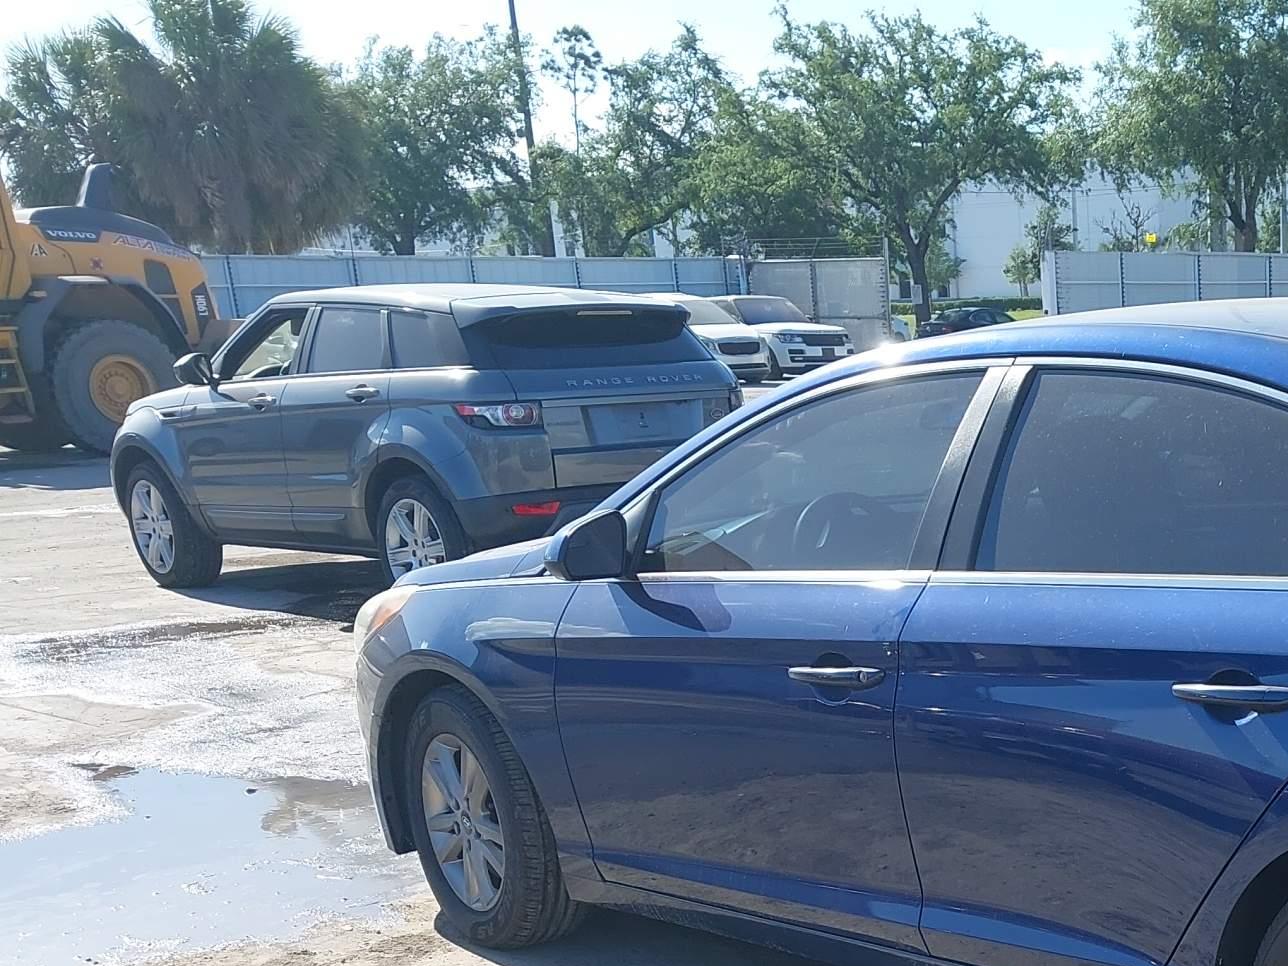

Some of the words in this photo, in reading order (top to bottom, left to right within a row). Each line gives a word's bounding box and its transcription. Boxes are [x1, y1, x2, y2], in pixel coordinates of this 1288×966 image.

[46, 229, 97, 239] VOLVO
[566, 377, 634, 388] RANGE
[647, 374, 703, 384] ROVER
